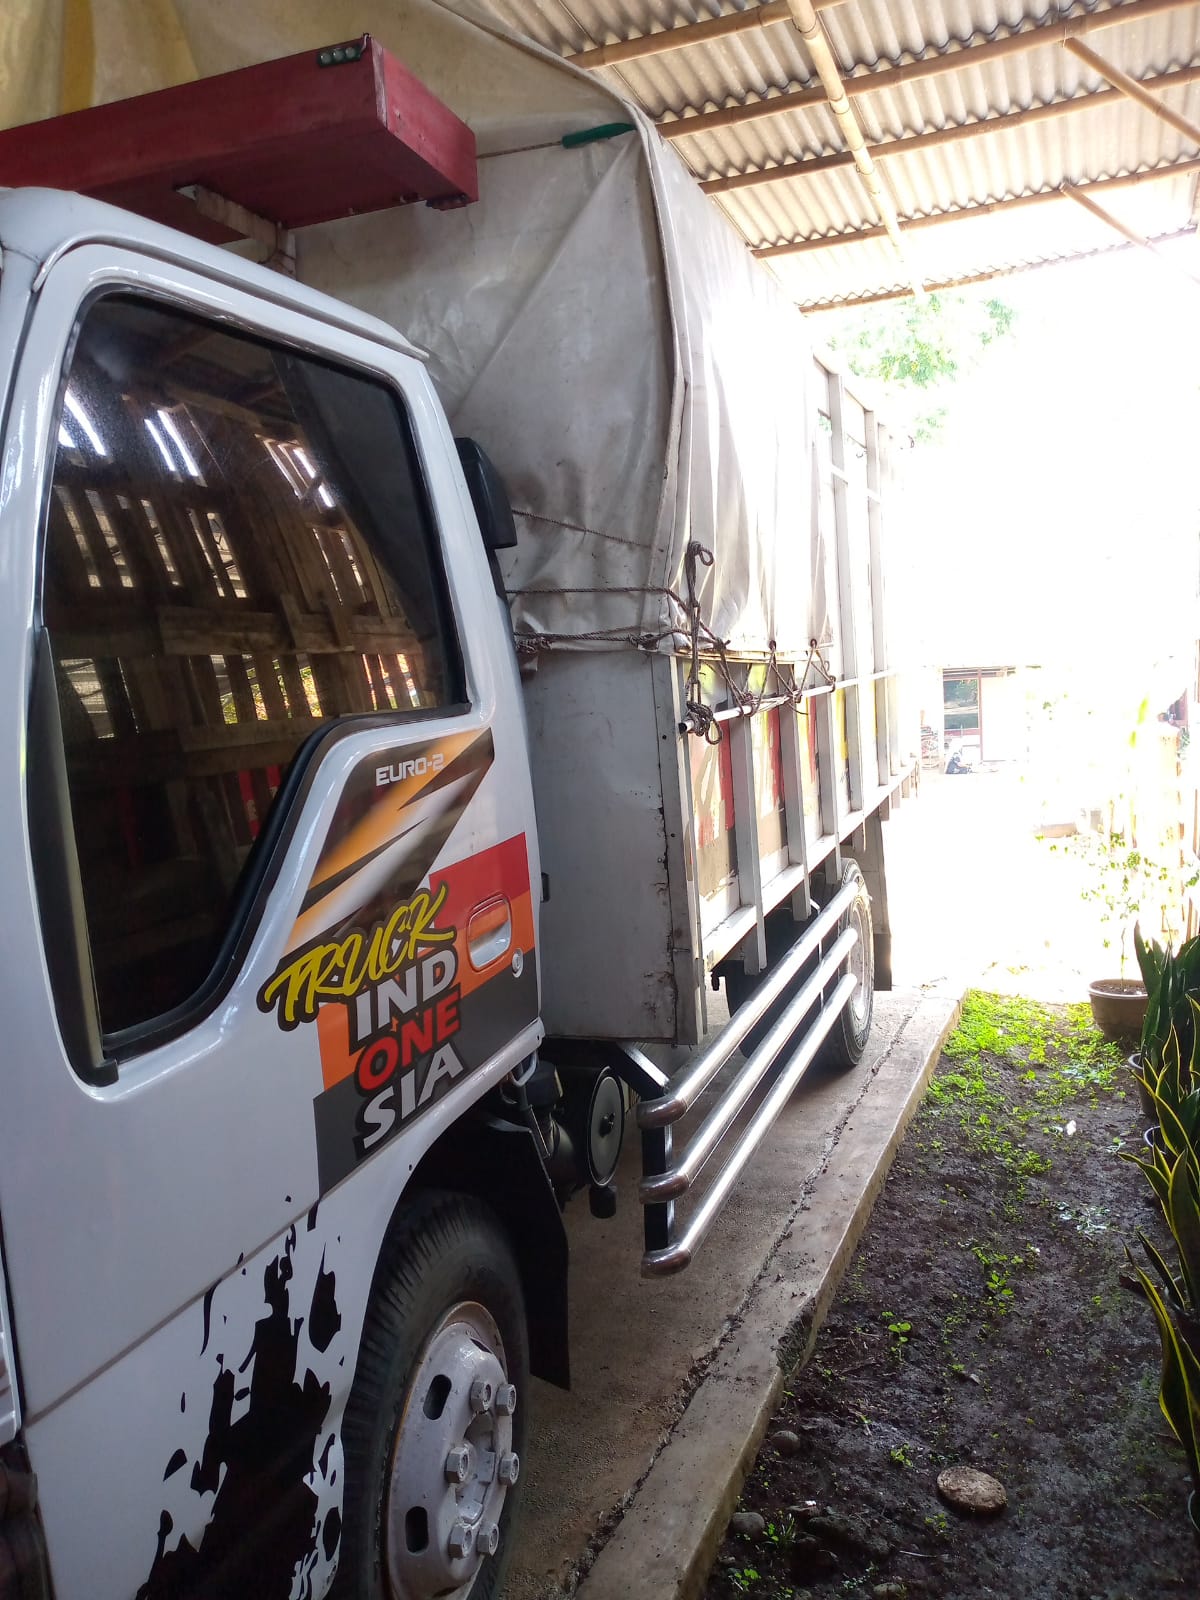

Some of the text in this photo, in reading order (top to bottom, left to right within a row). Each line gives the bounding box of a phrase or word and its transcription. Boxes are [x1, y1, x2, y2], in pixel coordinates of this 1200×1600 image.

[375, 753, 445, 786] EURO-2
[264, 885, 455, 1022] TRUCK
[355, 949, 456, 1041] IND
[357, 997, 460, 1092] ONE
[362, 1051, 464, 1150] SIA
